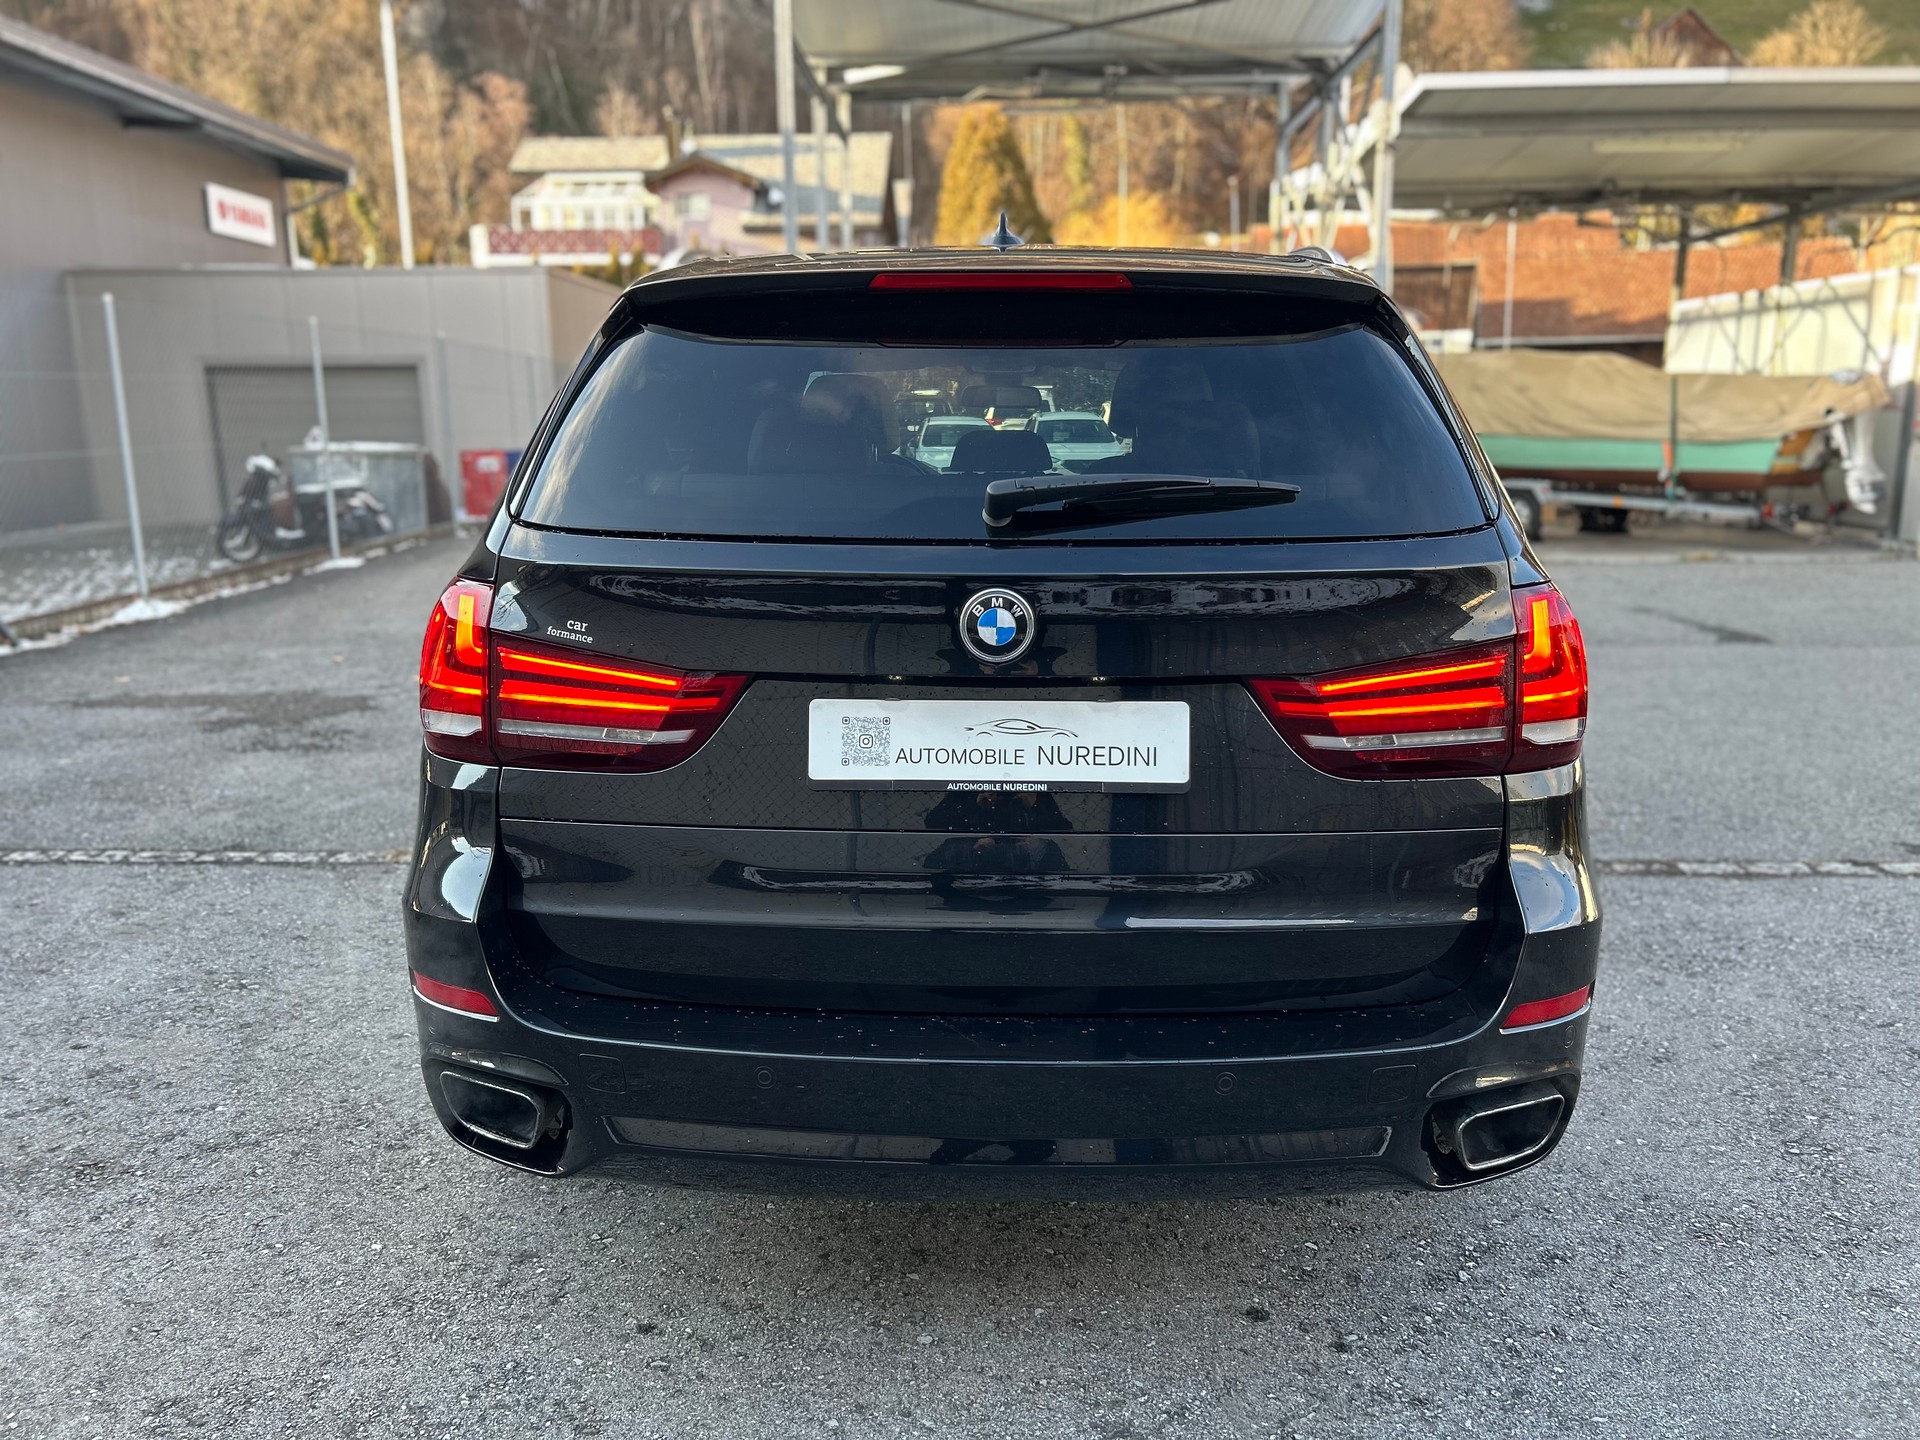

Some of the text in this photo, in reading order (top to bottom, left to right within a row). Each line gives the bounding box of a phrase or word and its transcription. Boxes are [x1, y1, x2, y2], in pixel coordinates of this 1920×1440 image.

[972, 597, 1023, 618] BMW
[547, 626, 593, 643] formance
[567, 620, 588, 632] car
[895, 745, 1157, 767] AUTOMOBILE NUREDINI
[946, 783, 1048, 791] AUTOMOBILE NUREDINI
